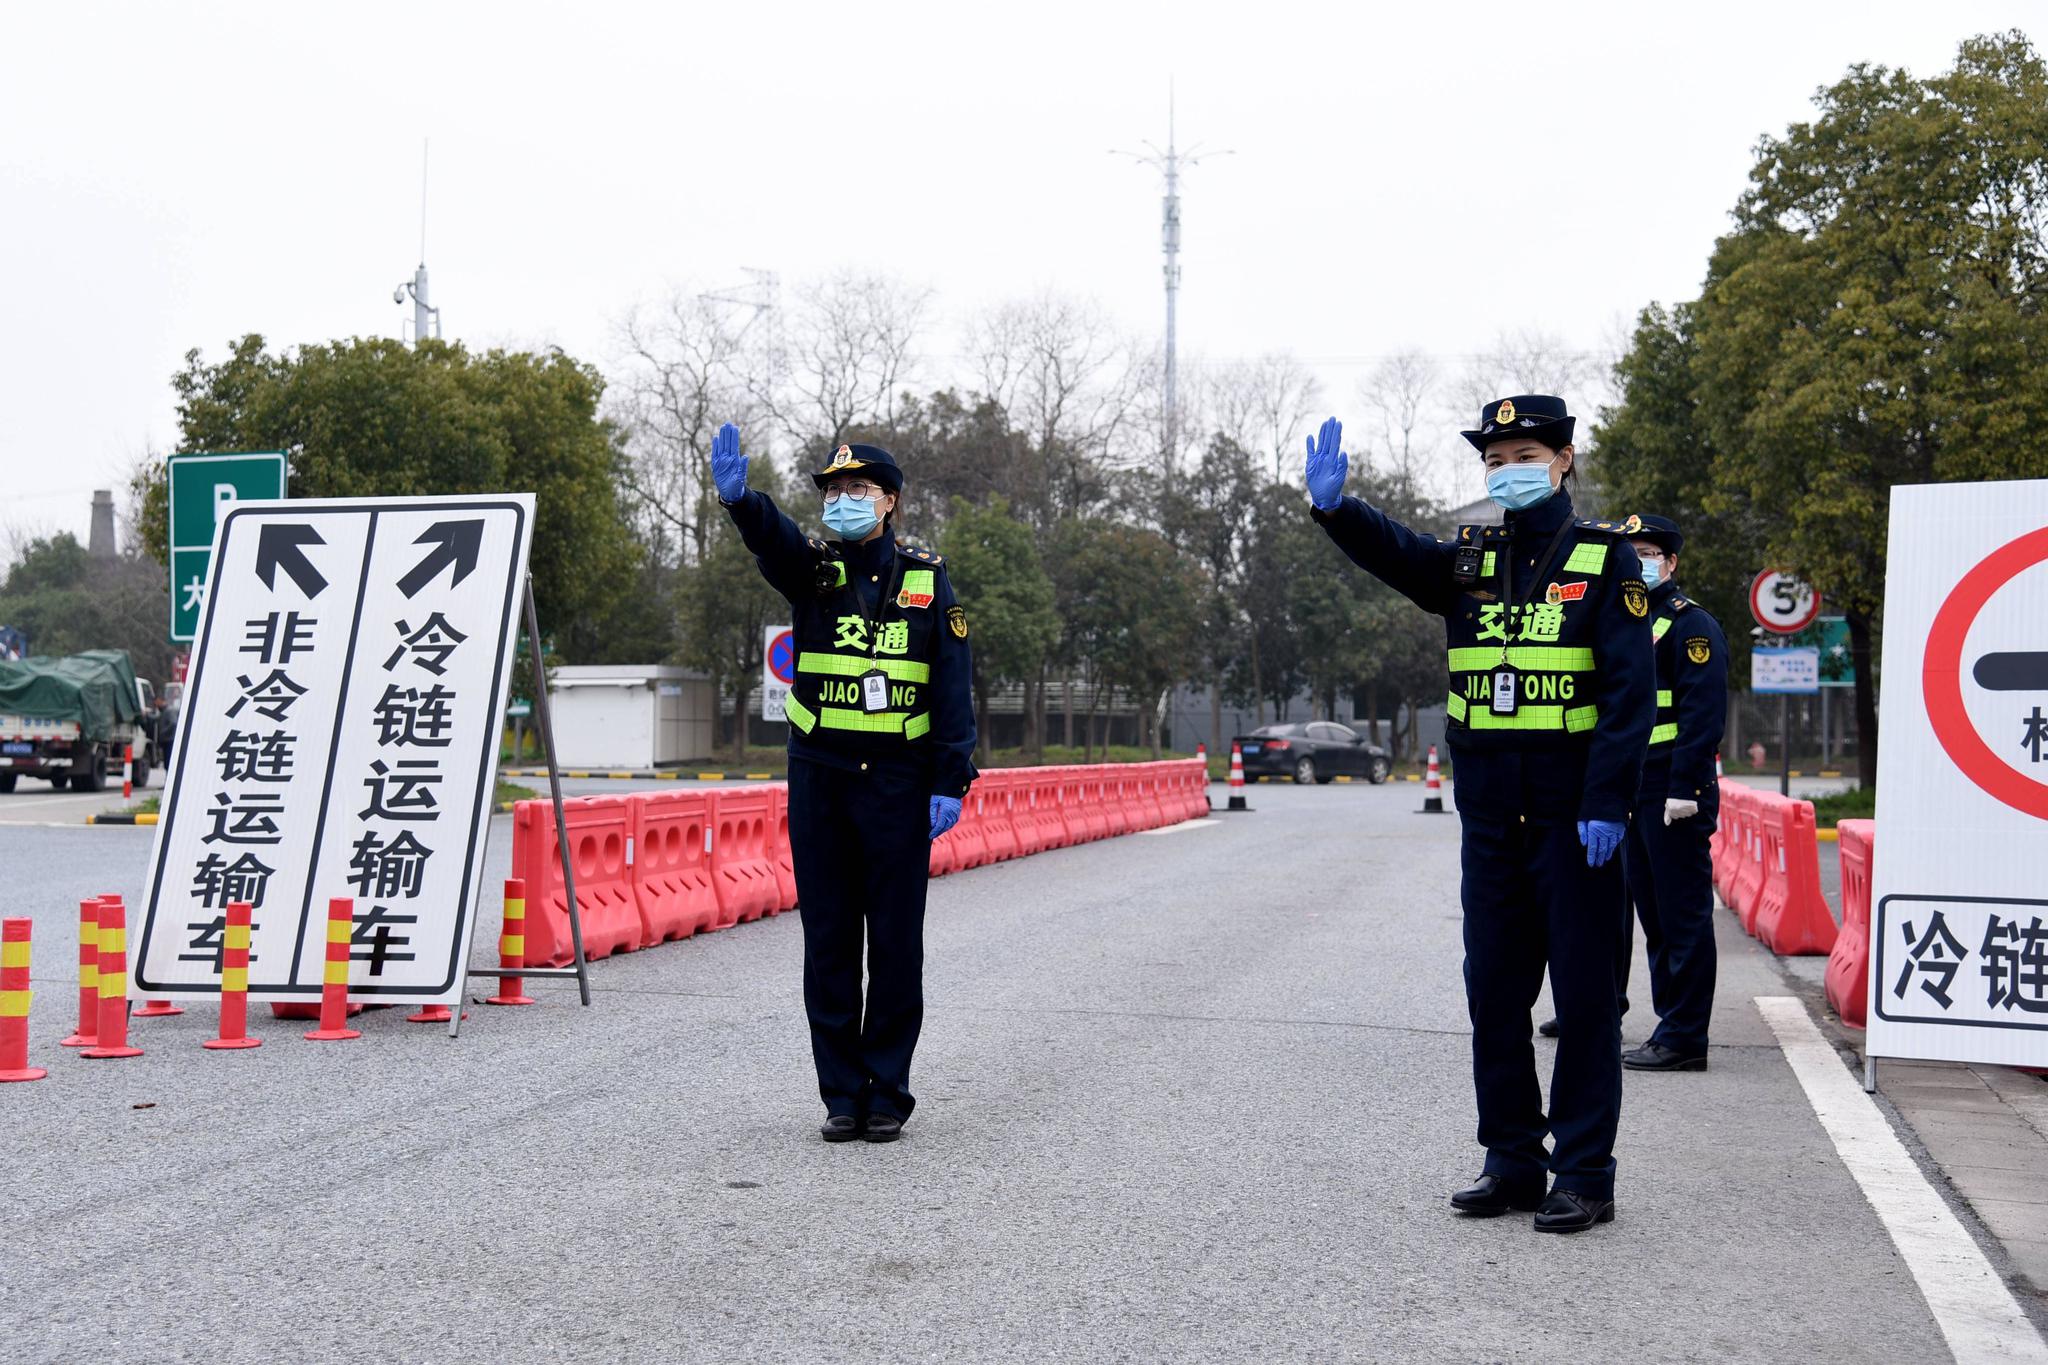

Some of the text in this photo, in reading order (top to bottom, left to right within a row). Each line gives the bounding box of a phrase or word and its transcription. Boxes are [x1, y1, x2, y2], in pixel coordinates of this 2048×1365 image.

[833, 614, 909, 655] 交通
[1476, 602, 1564, 642] 交通
[347, 611, 469, 976] 冷链运输车
[1893, 910, 2048, 1012] 冷链
